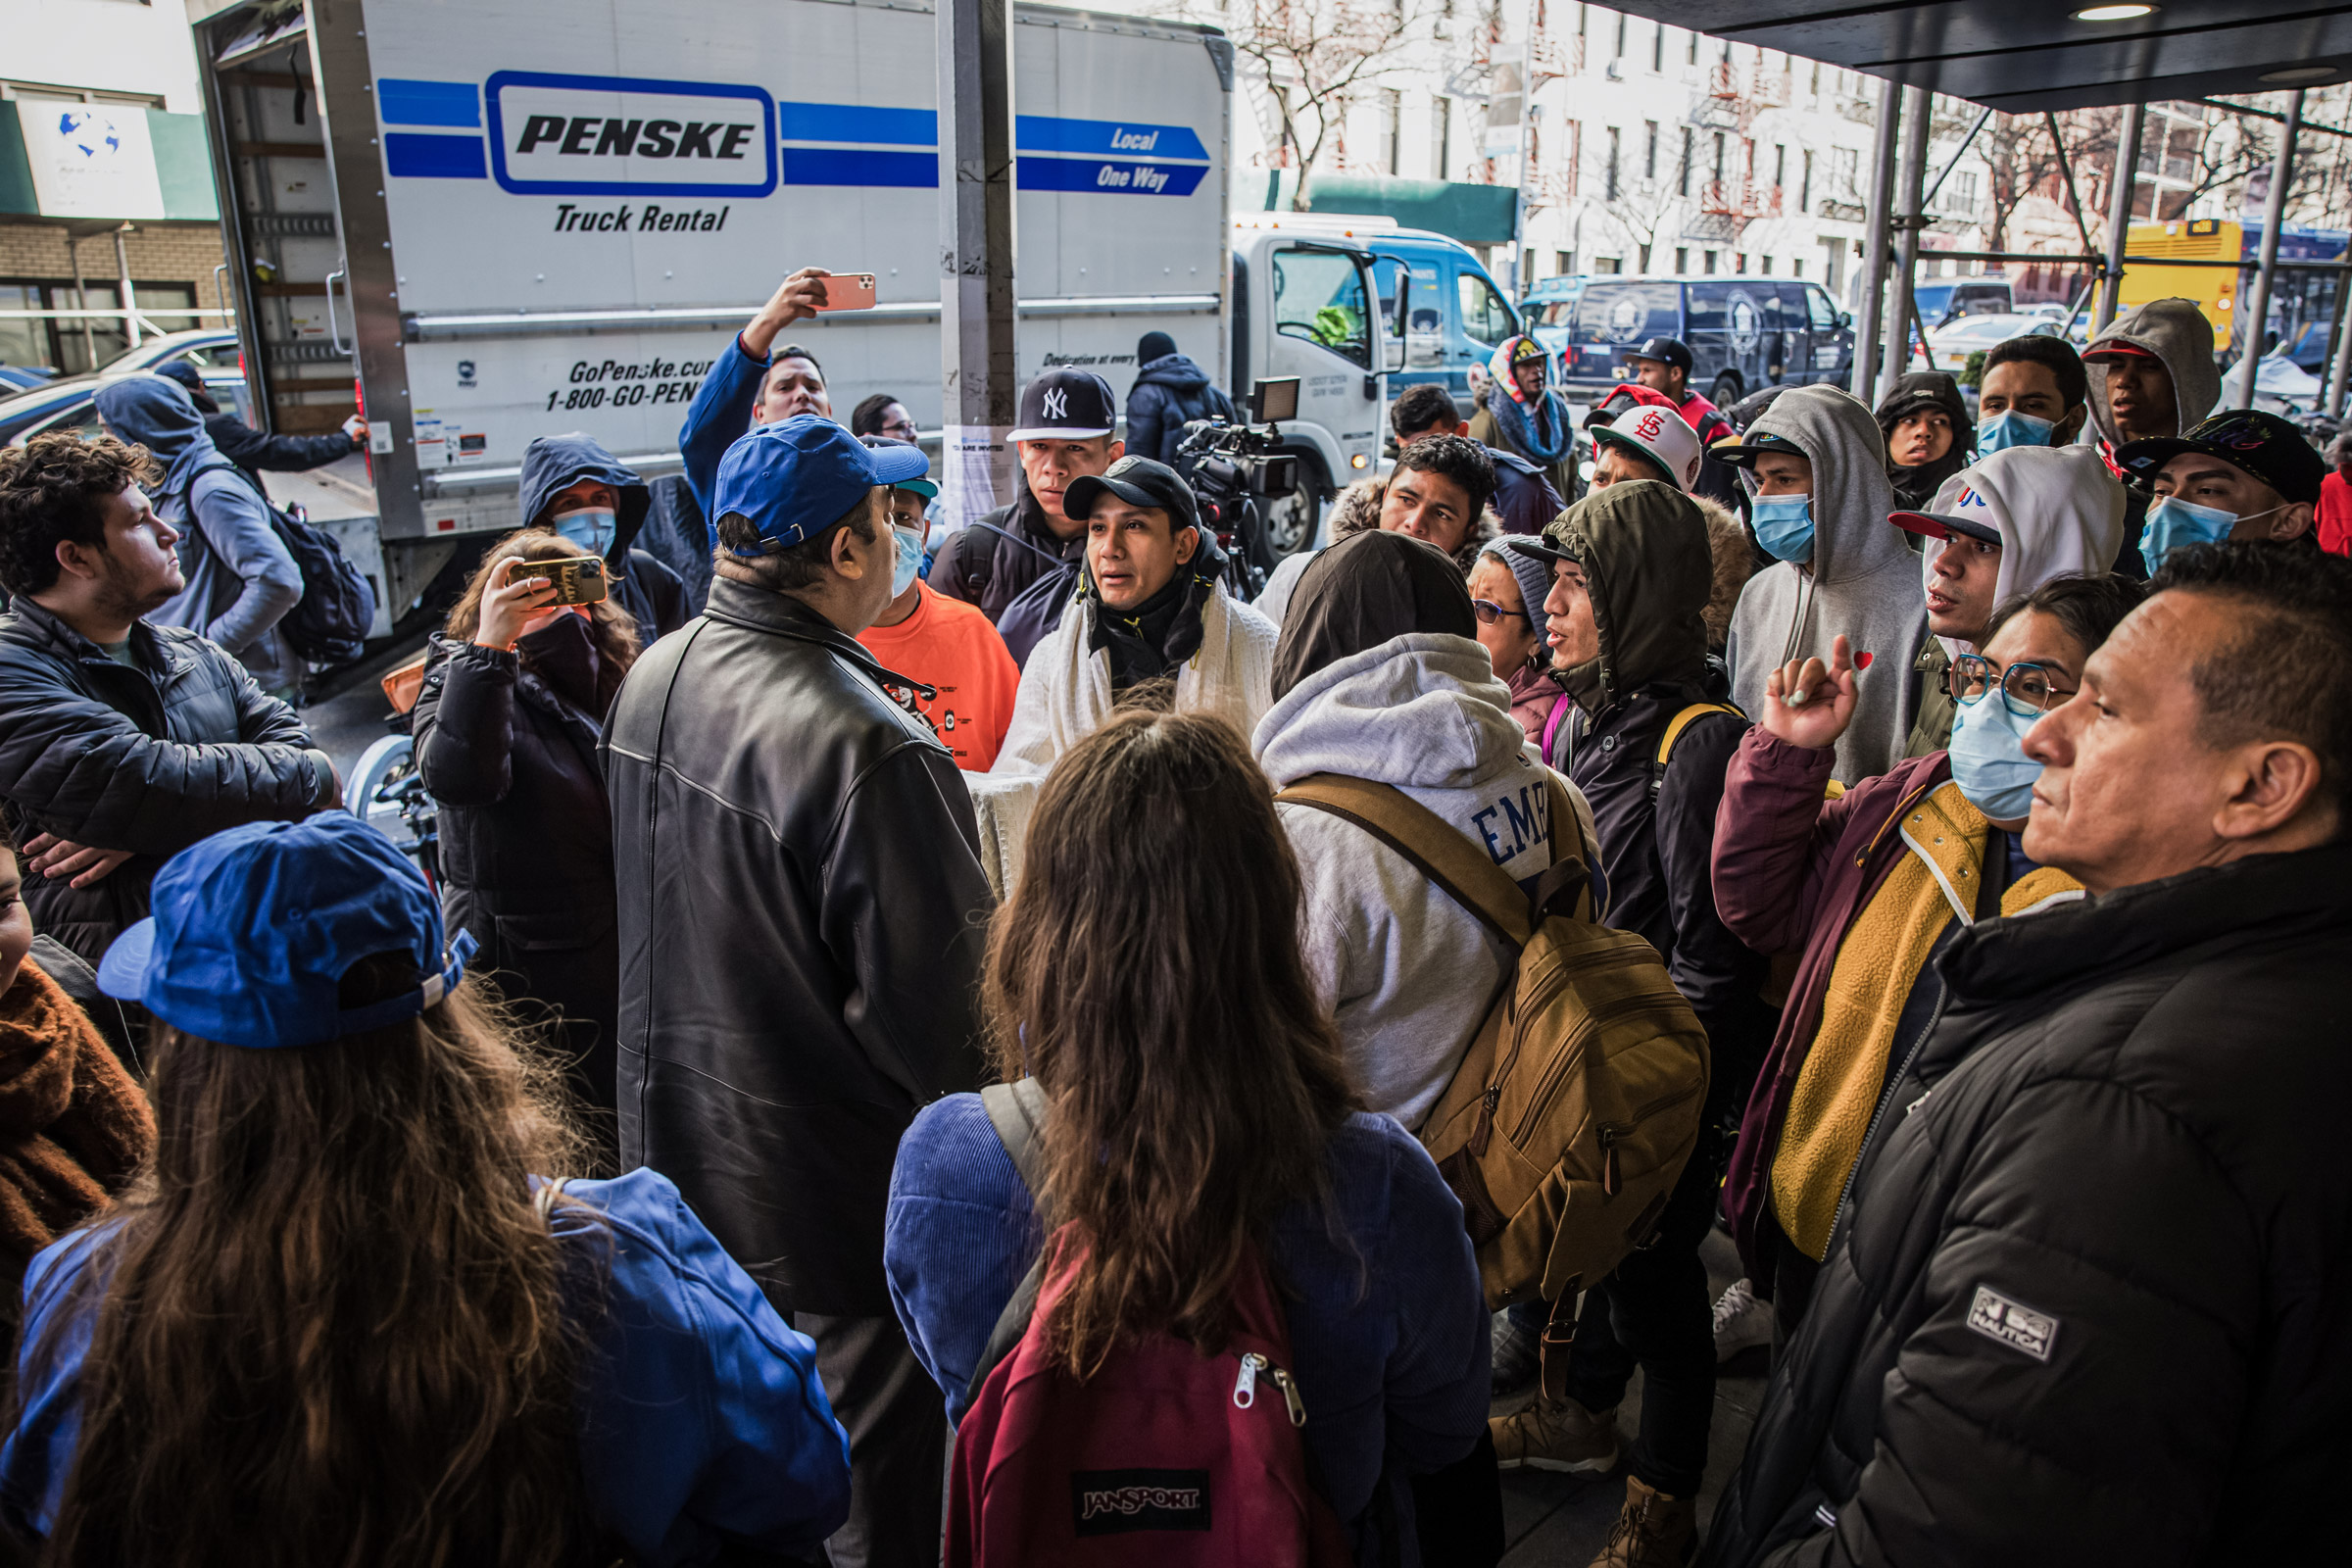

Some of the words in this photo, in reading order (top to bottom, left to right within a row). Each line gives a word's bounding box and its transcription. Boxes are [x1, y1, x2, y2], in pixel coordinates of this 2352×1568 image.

[515, 115, 756, 160] PENSKE
[1110, 127, 1159, 151] Local
[1097, 165, 1130, 187] One
[1132, 167, 1169, 193] Way
[554, 204, 633, 232] Truck
[638, 205, 730, 232] Rental
[1043, 352, 1096, 367] Dedication
[1098, 355, 1109, 365] at
[1110, 355, 1136, 367] every
[1042, 387, 1068, 419] NY
[1471, 780, 1548, 866] EMB
[1972, 1311, 2043, 1353] NAUTICA
